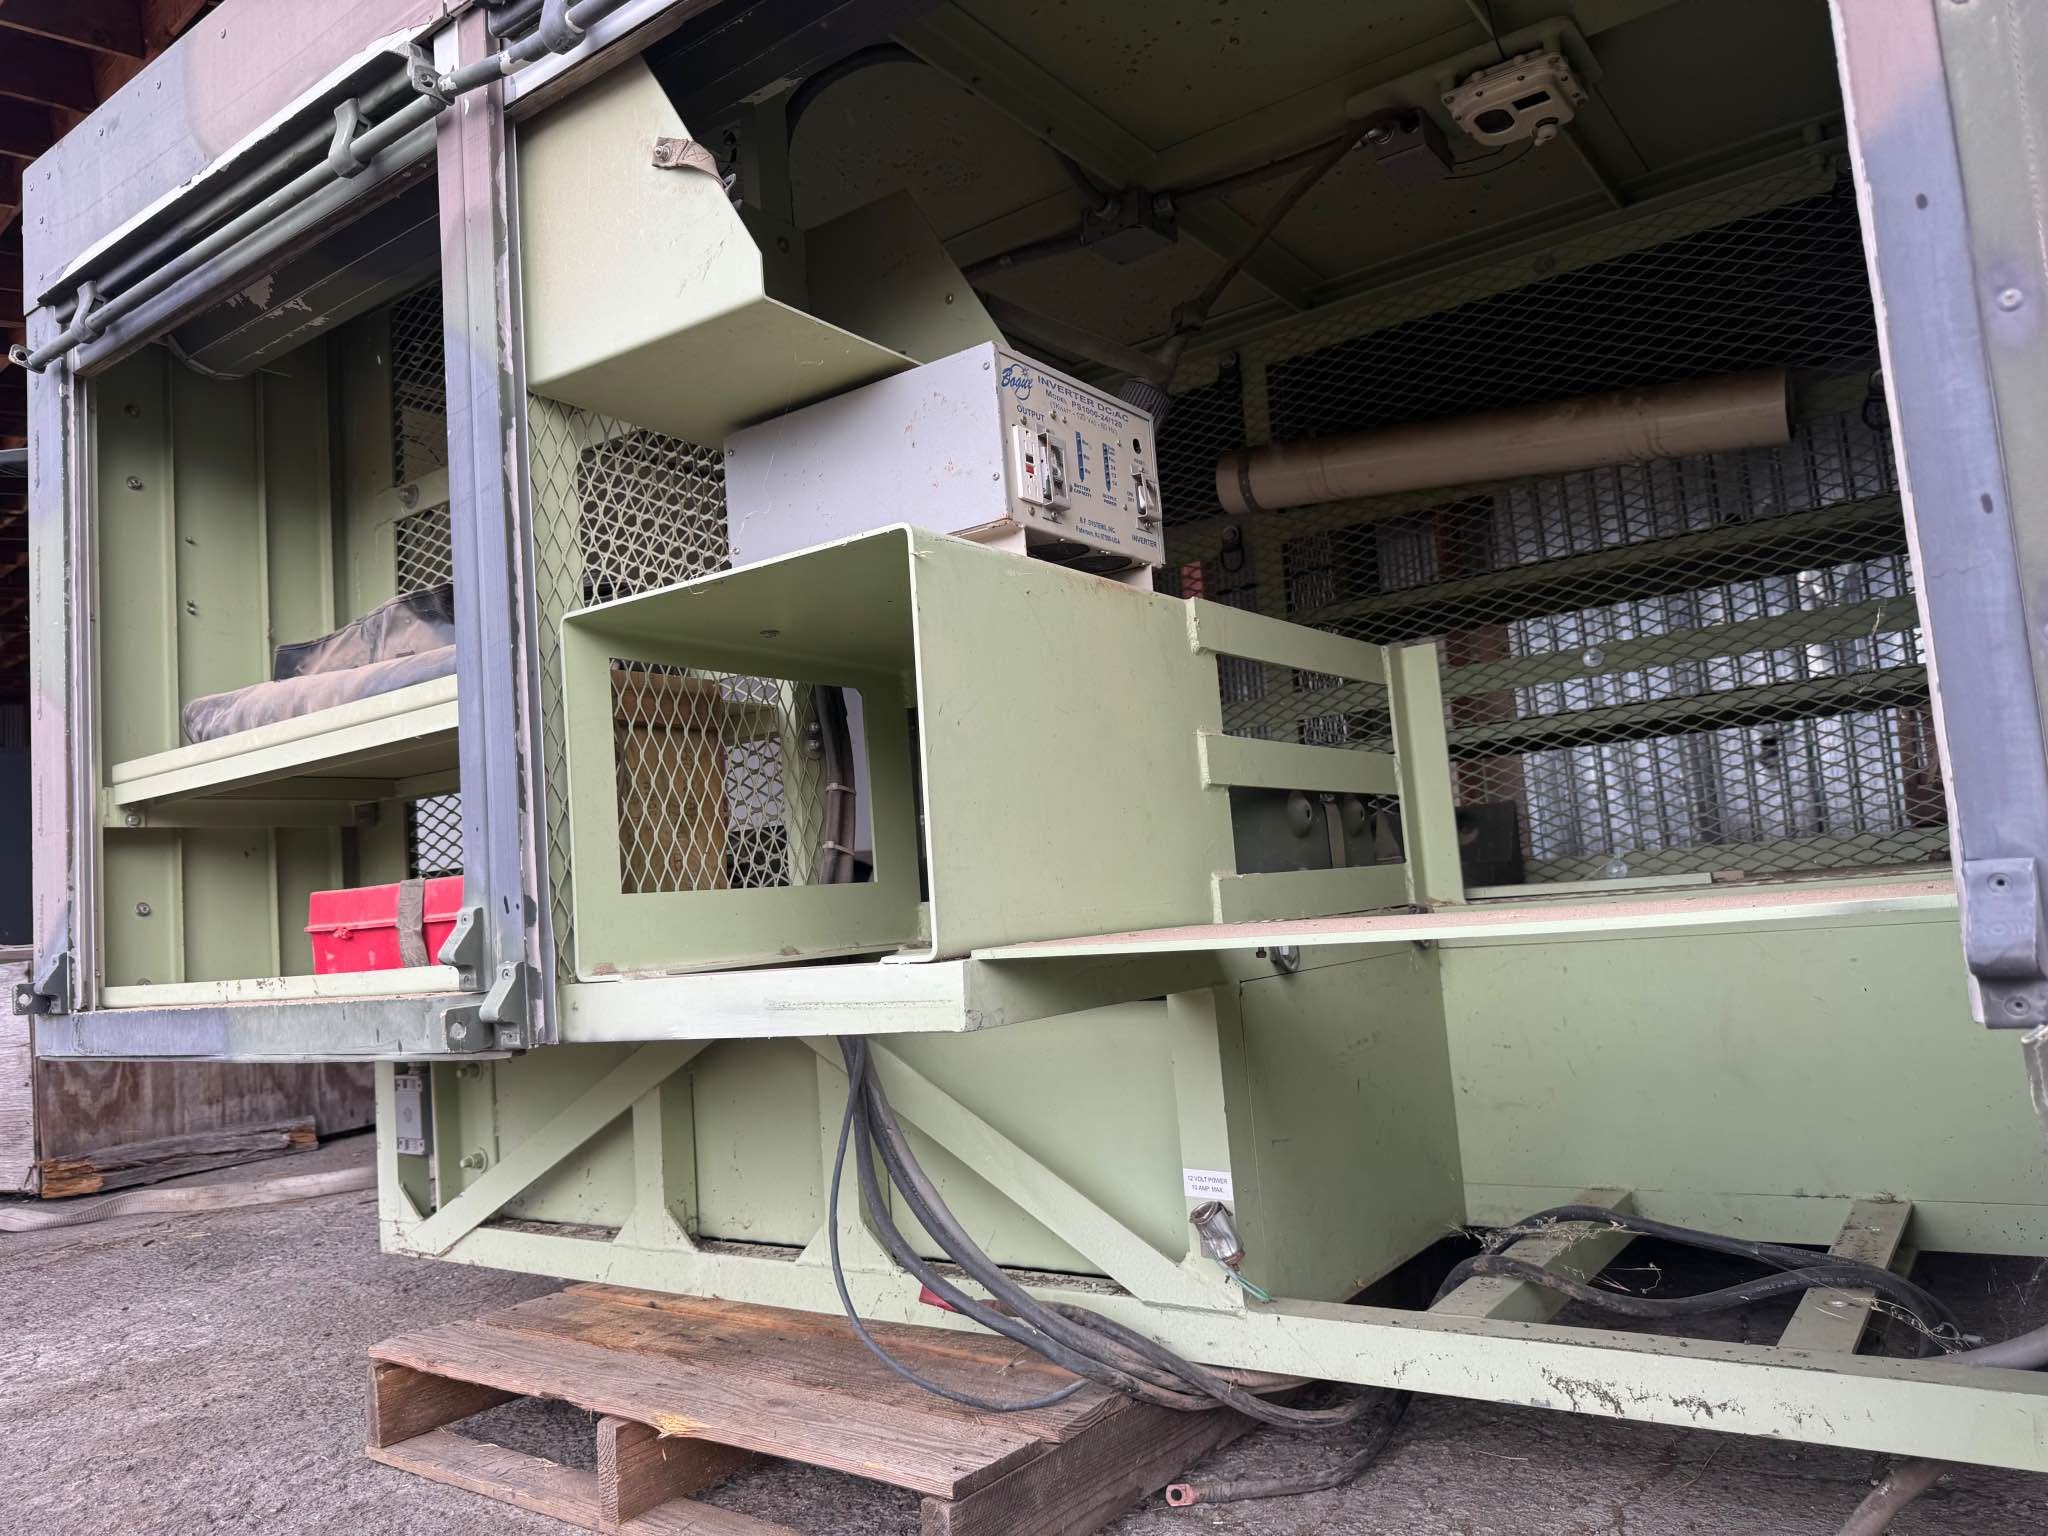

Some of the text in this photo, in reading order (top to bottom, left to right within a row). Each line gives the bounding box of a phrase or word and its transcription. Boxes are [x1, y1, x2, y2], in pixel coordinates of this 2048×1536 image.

[1037, 375, 1095, 408] INVERTER
[1016, 404, 1045, 422] OUTPUT
[1131, 534, 1158, 548] INVERTER
[1194, 1175, 1207, 1183] VOLT
[1208, 1176, 1228, 1185] POWER
